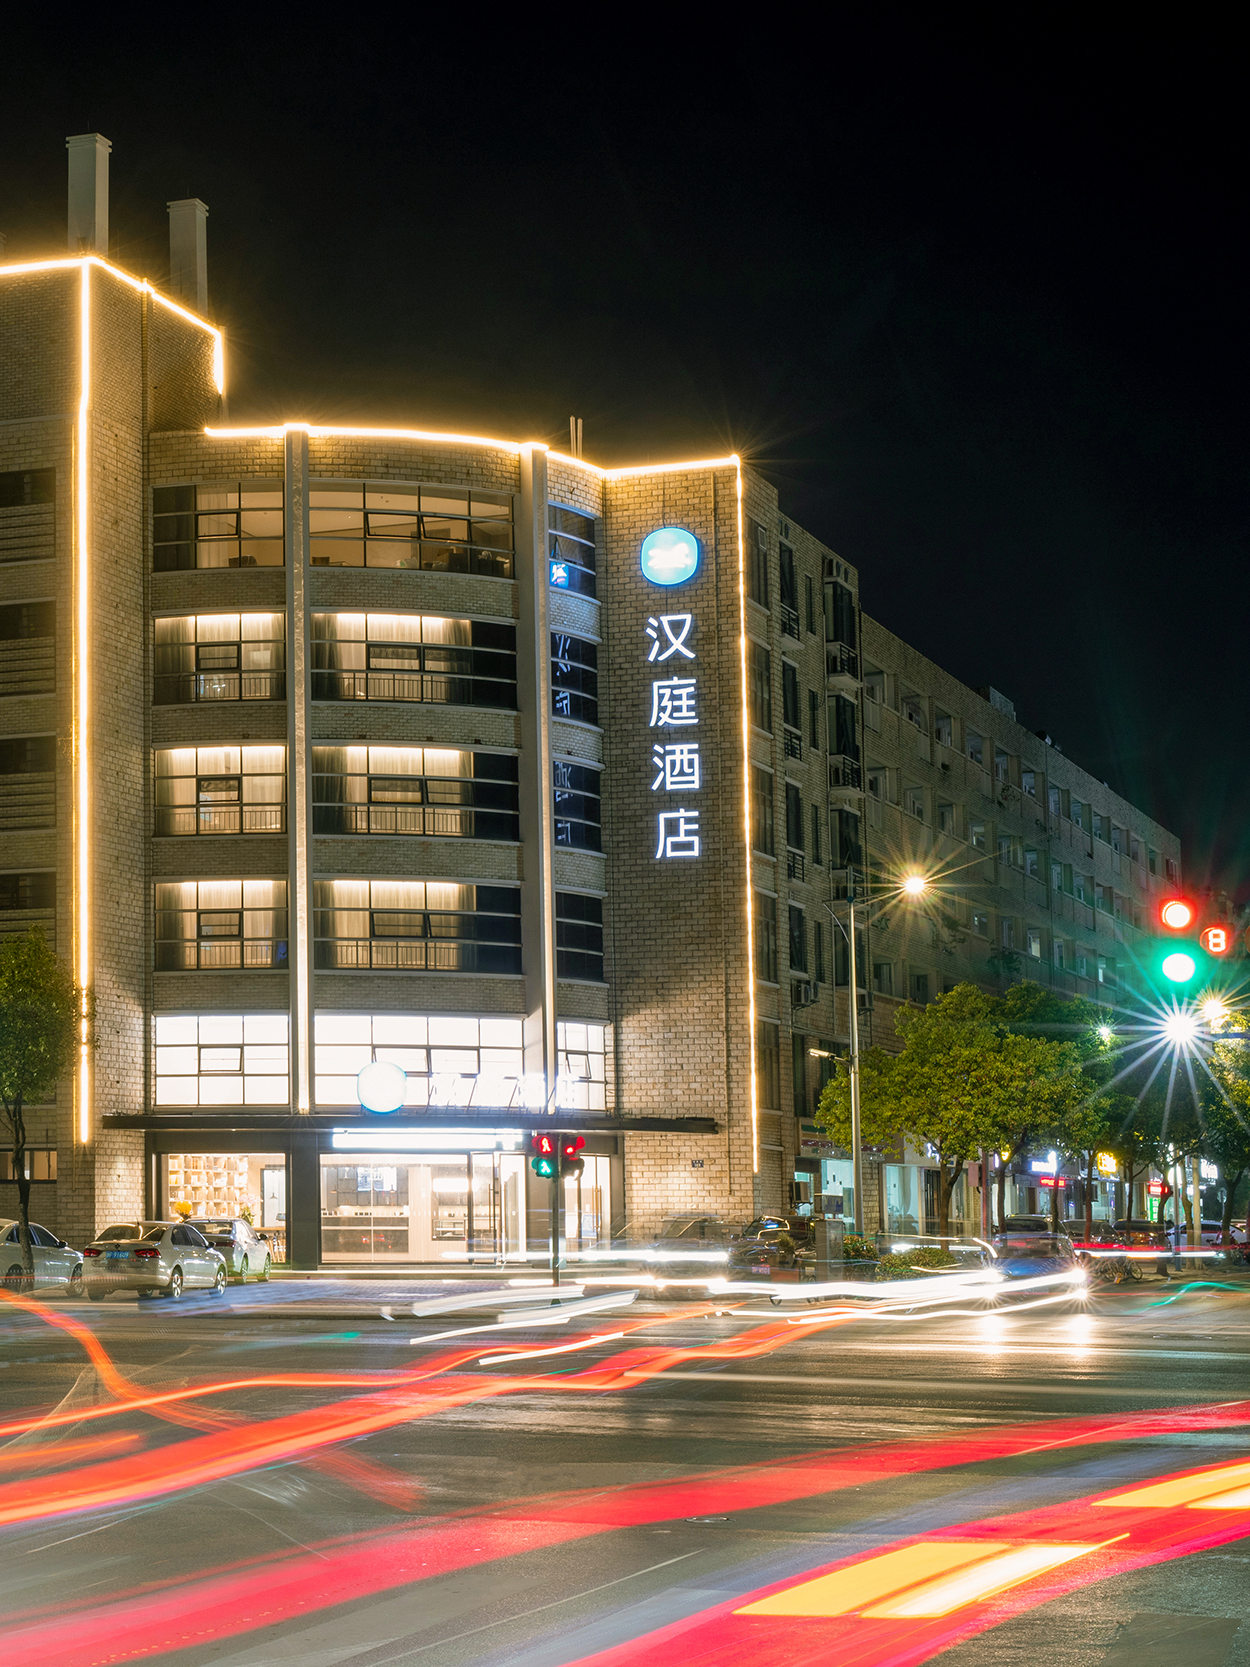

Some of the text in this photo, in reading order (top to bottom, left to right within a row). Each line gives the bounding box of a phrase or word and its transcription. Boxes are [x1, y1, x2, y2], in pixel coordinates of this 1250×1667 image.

[645, 613, 701, 859] 汉庭酒店
[1208, 929, 1226, 952] 8
